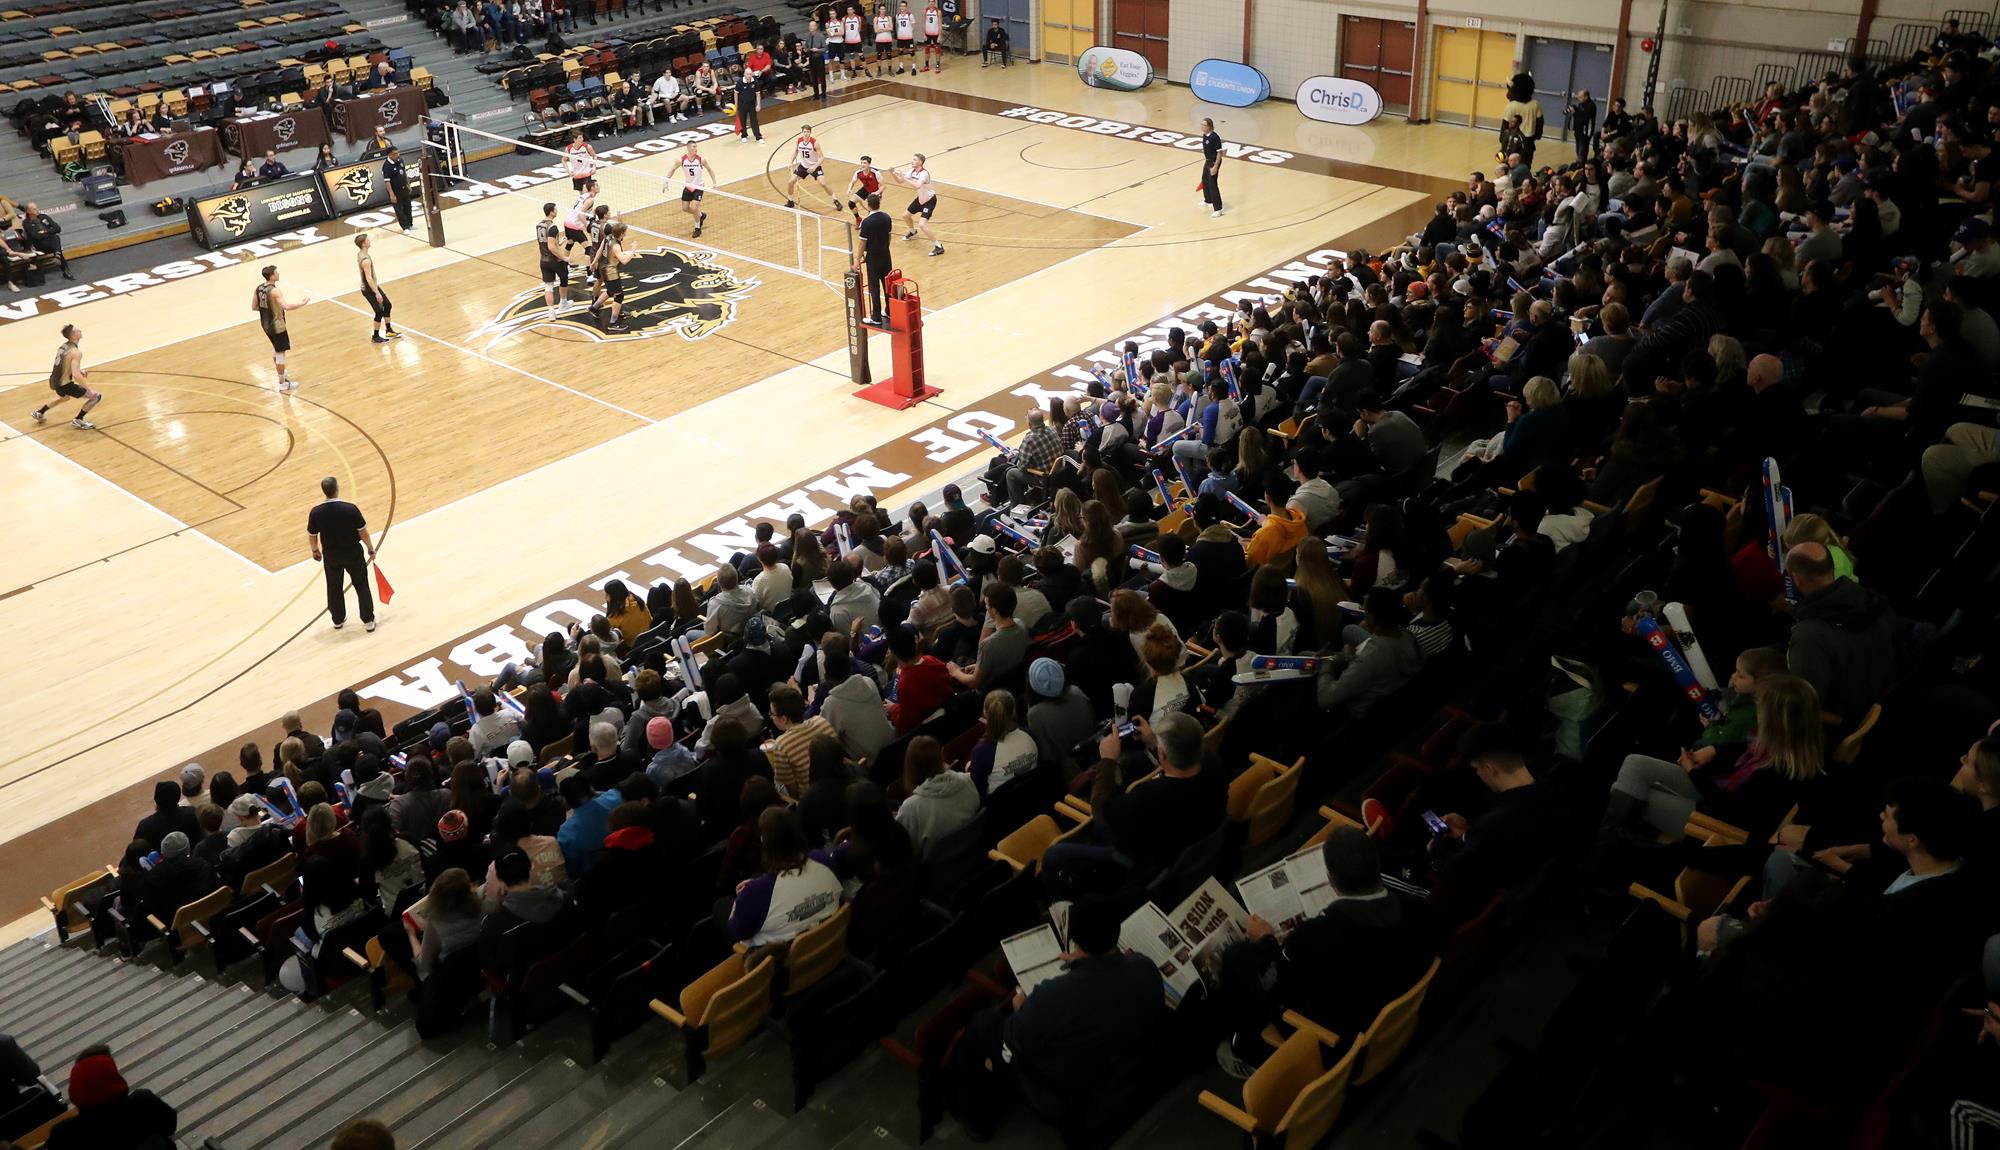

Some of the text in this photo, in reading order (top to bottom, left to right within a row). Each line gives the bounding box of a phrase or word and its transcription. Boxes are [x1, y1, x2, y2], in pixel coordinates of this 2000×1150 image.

[439, 123, 737, 203] MANTOBA
[801, 150, 810, 159] 15
[689, 168, 695, 176] 5
[260, 194, 286, 205] UNIVERSITY
[292, 187, 315, 197] MANITOBA
[909, 410, 1016, 464] OF
[1661, 649, 1684, 673] BMO
